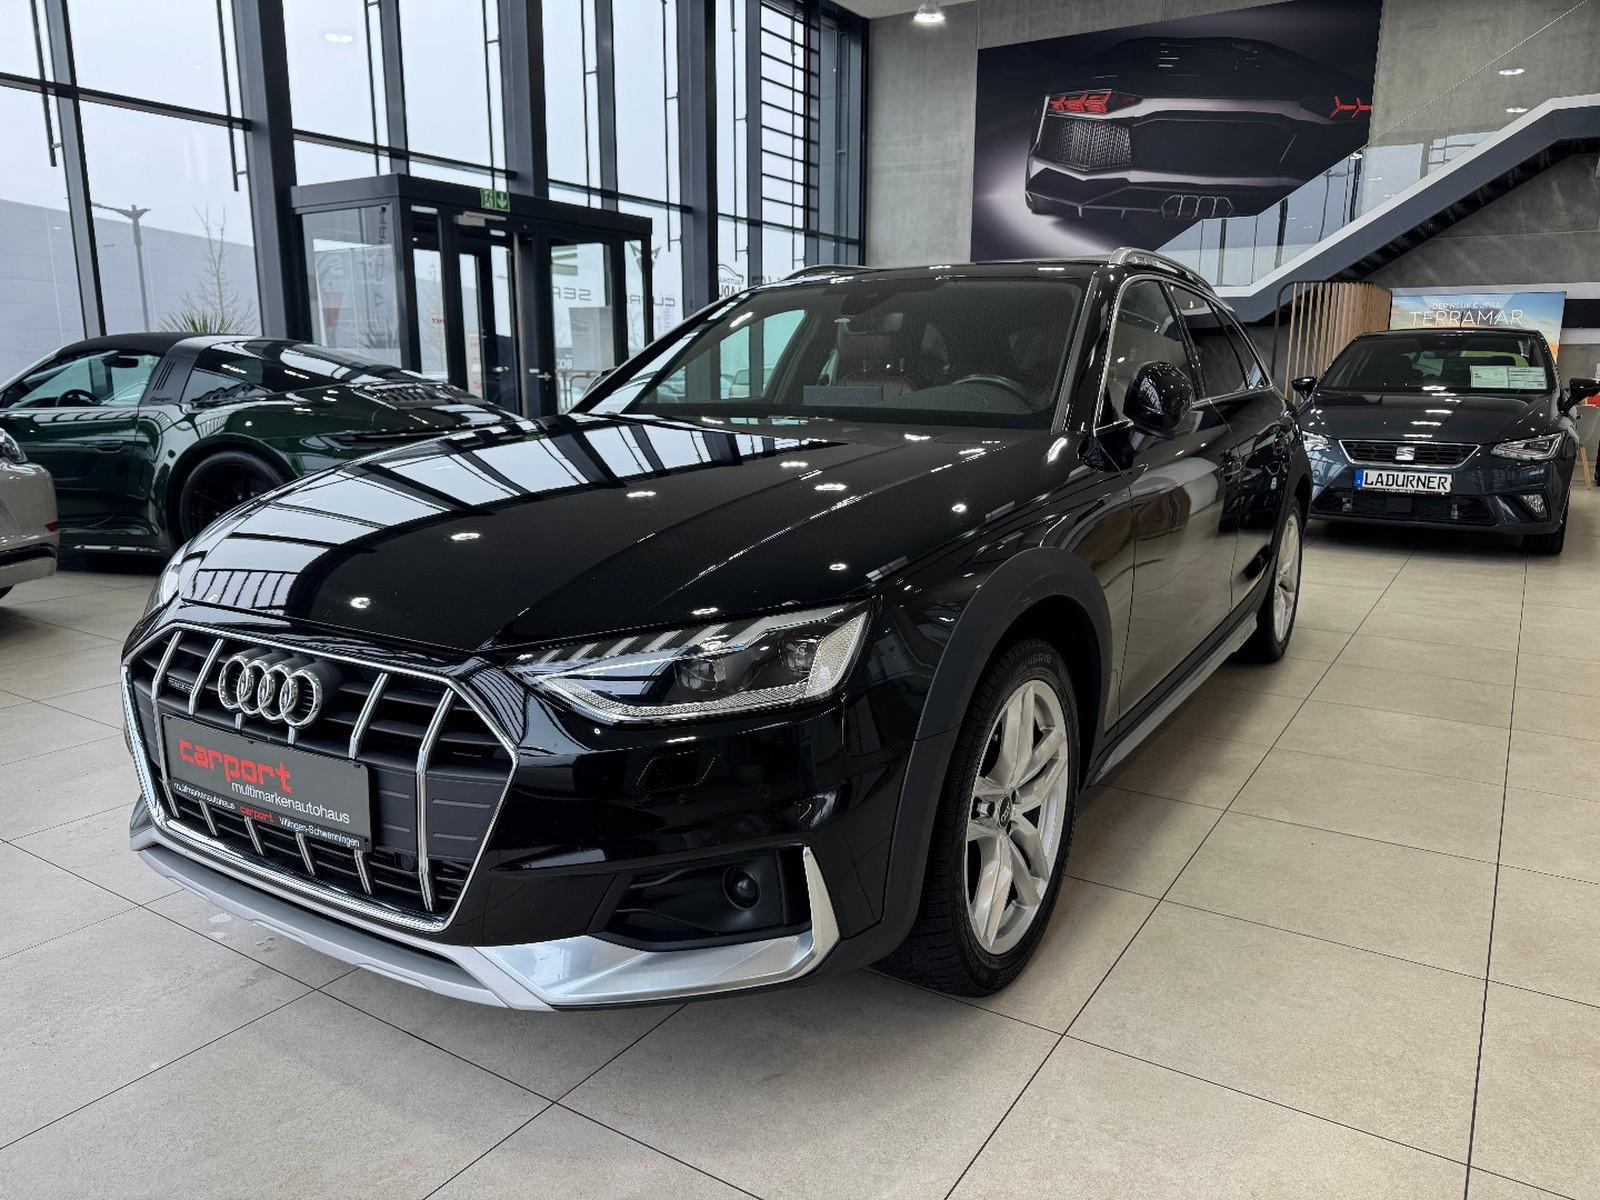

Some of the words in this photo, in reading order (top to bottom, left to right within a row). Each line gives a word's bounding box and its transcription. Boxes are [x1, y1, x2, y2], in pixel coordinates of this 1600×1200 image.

[1433, 302, 1448, 310] DER
[1473, 301, 1502, 309] CUPRA
[1411, 309, 1523, 326] TERRAMAR
[1364, 472, 1448, 490] LADURNER
[179, 739, 293, 793] carport
[231, 782, 351, 825] multimarkenautohaus
[239, 805, 274, 825] carport
